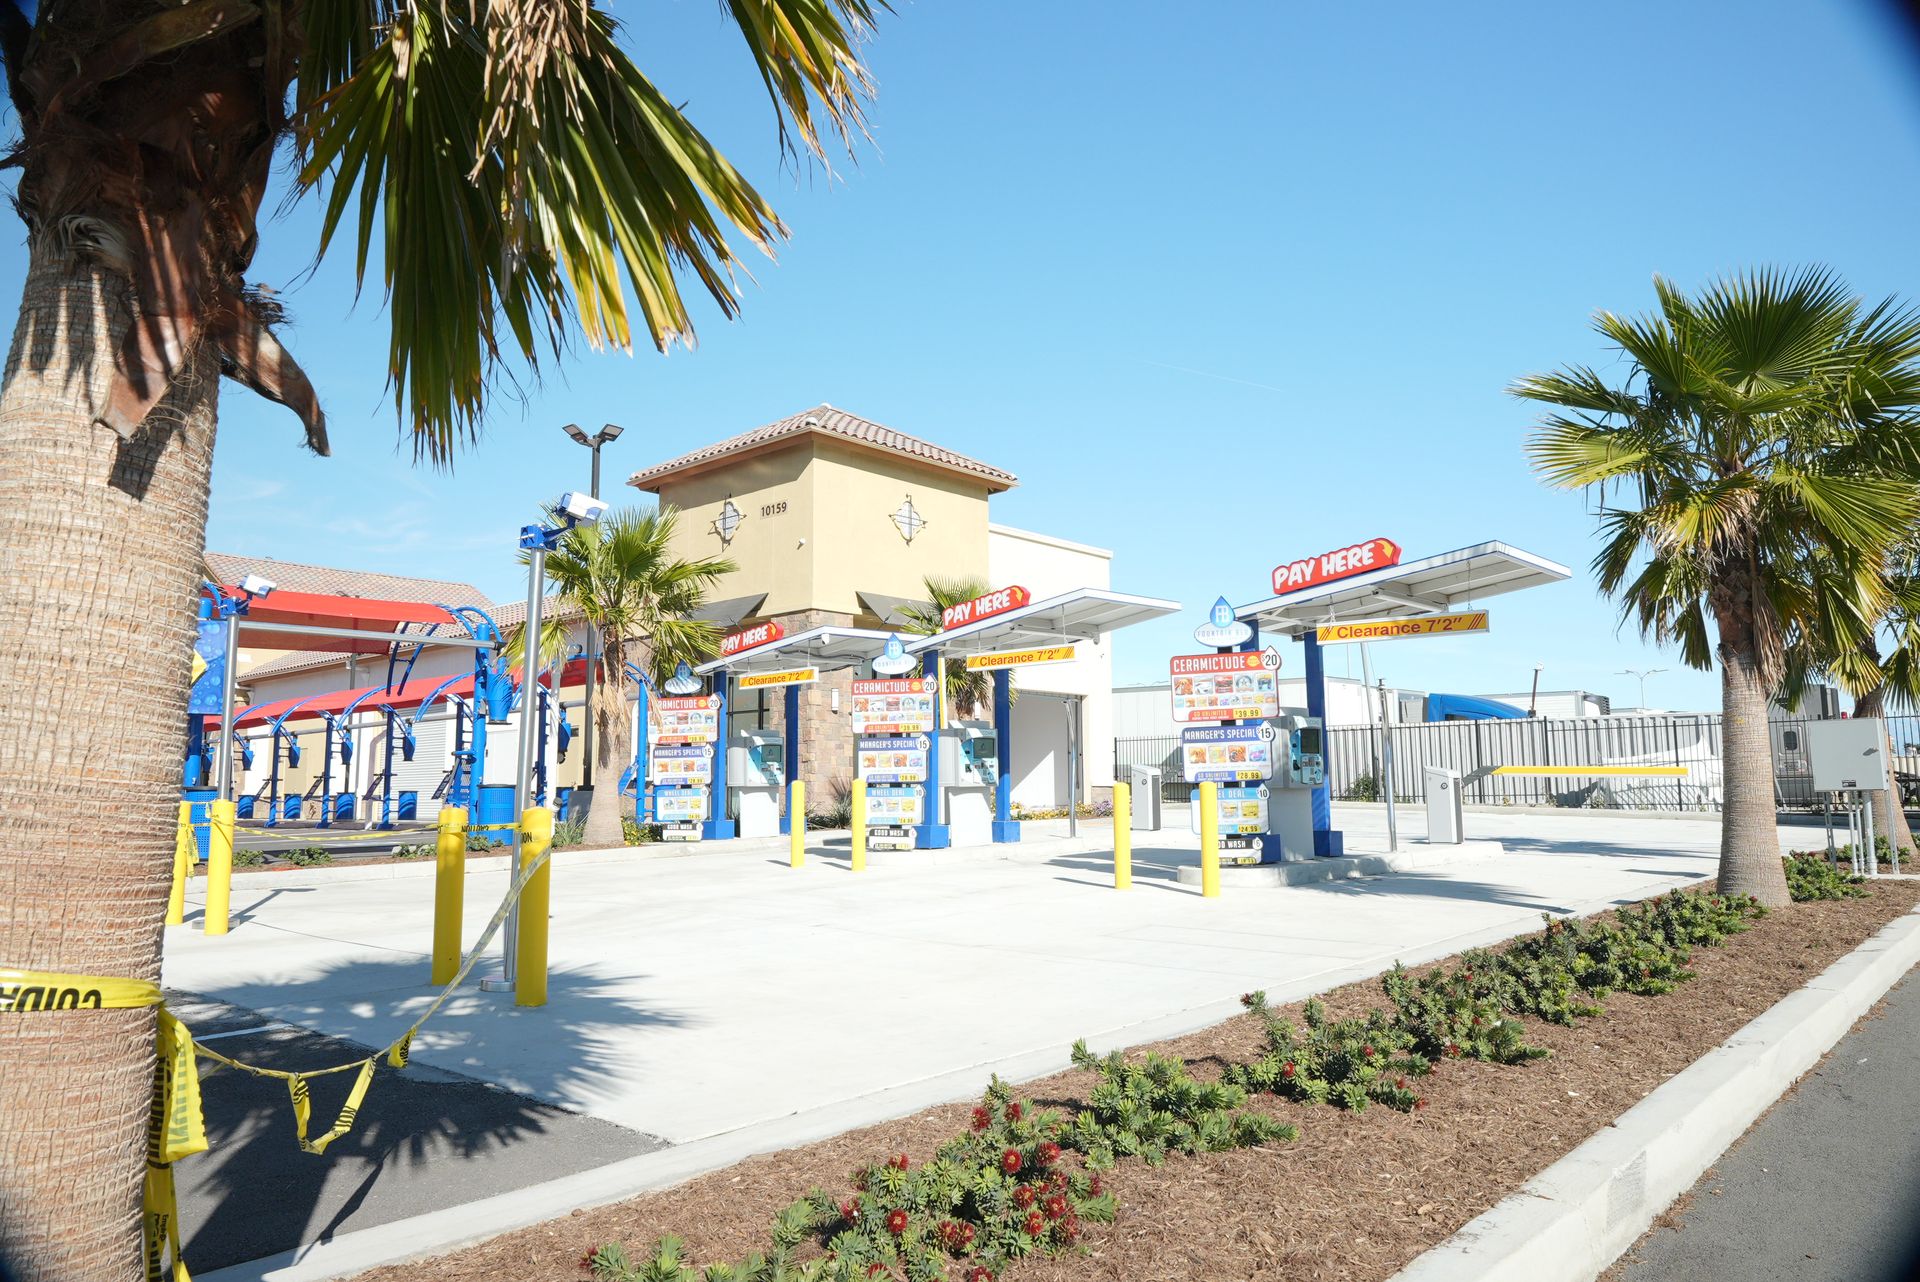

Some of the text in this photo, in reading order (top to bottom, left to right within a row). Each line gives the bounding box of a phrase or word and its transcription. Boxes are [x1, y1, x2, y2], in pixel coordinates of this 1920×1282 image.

[760, 501, 788, 517] 10159
[1274, 542, 1375, 589] PAY HERE
[944, 589, 1011, 626] PAY HERE
[1337, 623, 1421, 639] Clearance
[721, 624, 769, 654] PAY HERE
[979, 652, 1034, 667] Clearance
[1173, 655, 1246, 673] CERAMICTUDE
[748, 673, 786, 687] Clearance
[853, 681, 911, 694] CERAMICTUDE
[1184, 729, 1257, 741] MANAGER'S SPECIAL
[860, 740, 916, 749] MANAGER'S SPECIAL
[682, 748, 702, 756] SPECIAL
[1228, 789, 1245, 798] DEAL
[1227, 840, 1247, 849] WASH
